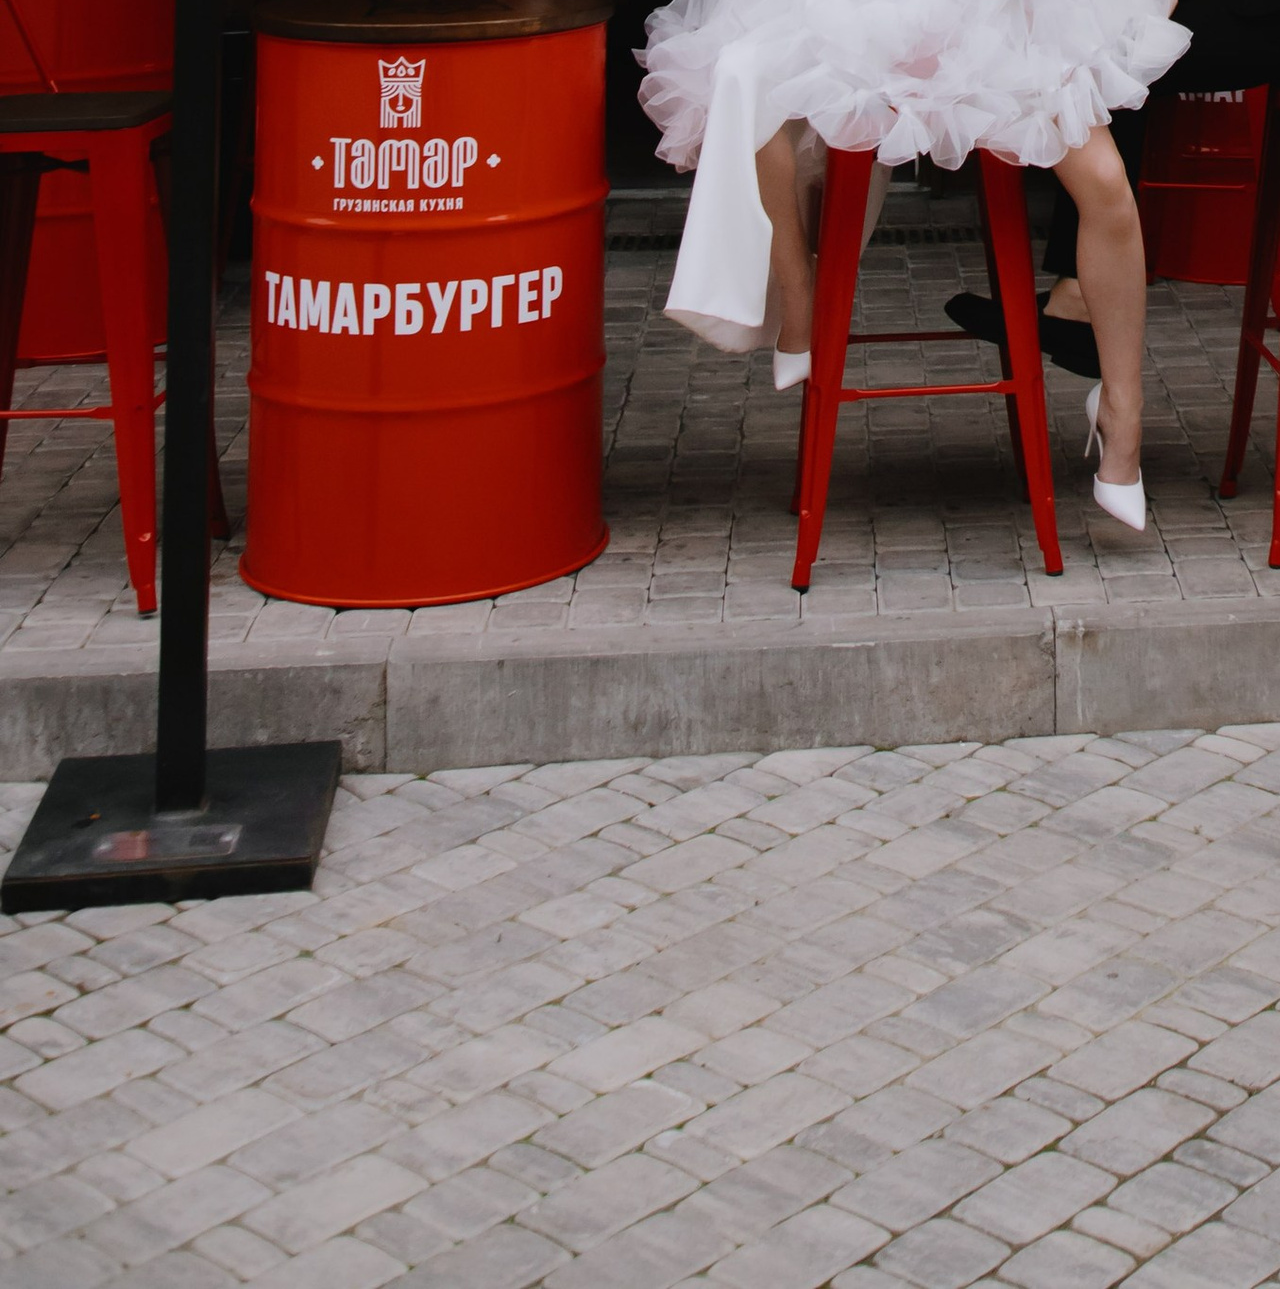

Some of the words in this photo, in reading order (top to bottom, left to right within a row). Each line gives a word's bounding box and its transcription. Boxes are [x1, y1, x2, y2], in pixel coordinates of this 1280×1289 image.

[333, 198, 414, 212] ГРУЗИНСКАЯ
[420, 197, 464, 212] КУХНЯ
[265, 266, 563, 335] ТАМАРБУРГЕР
